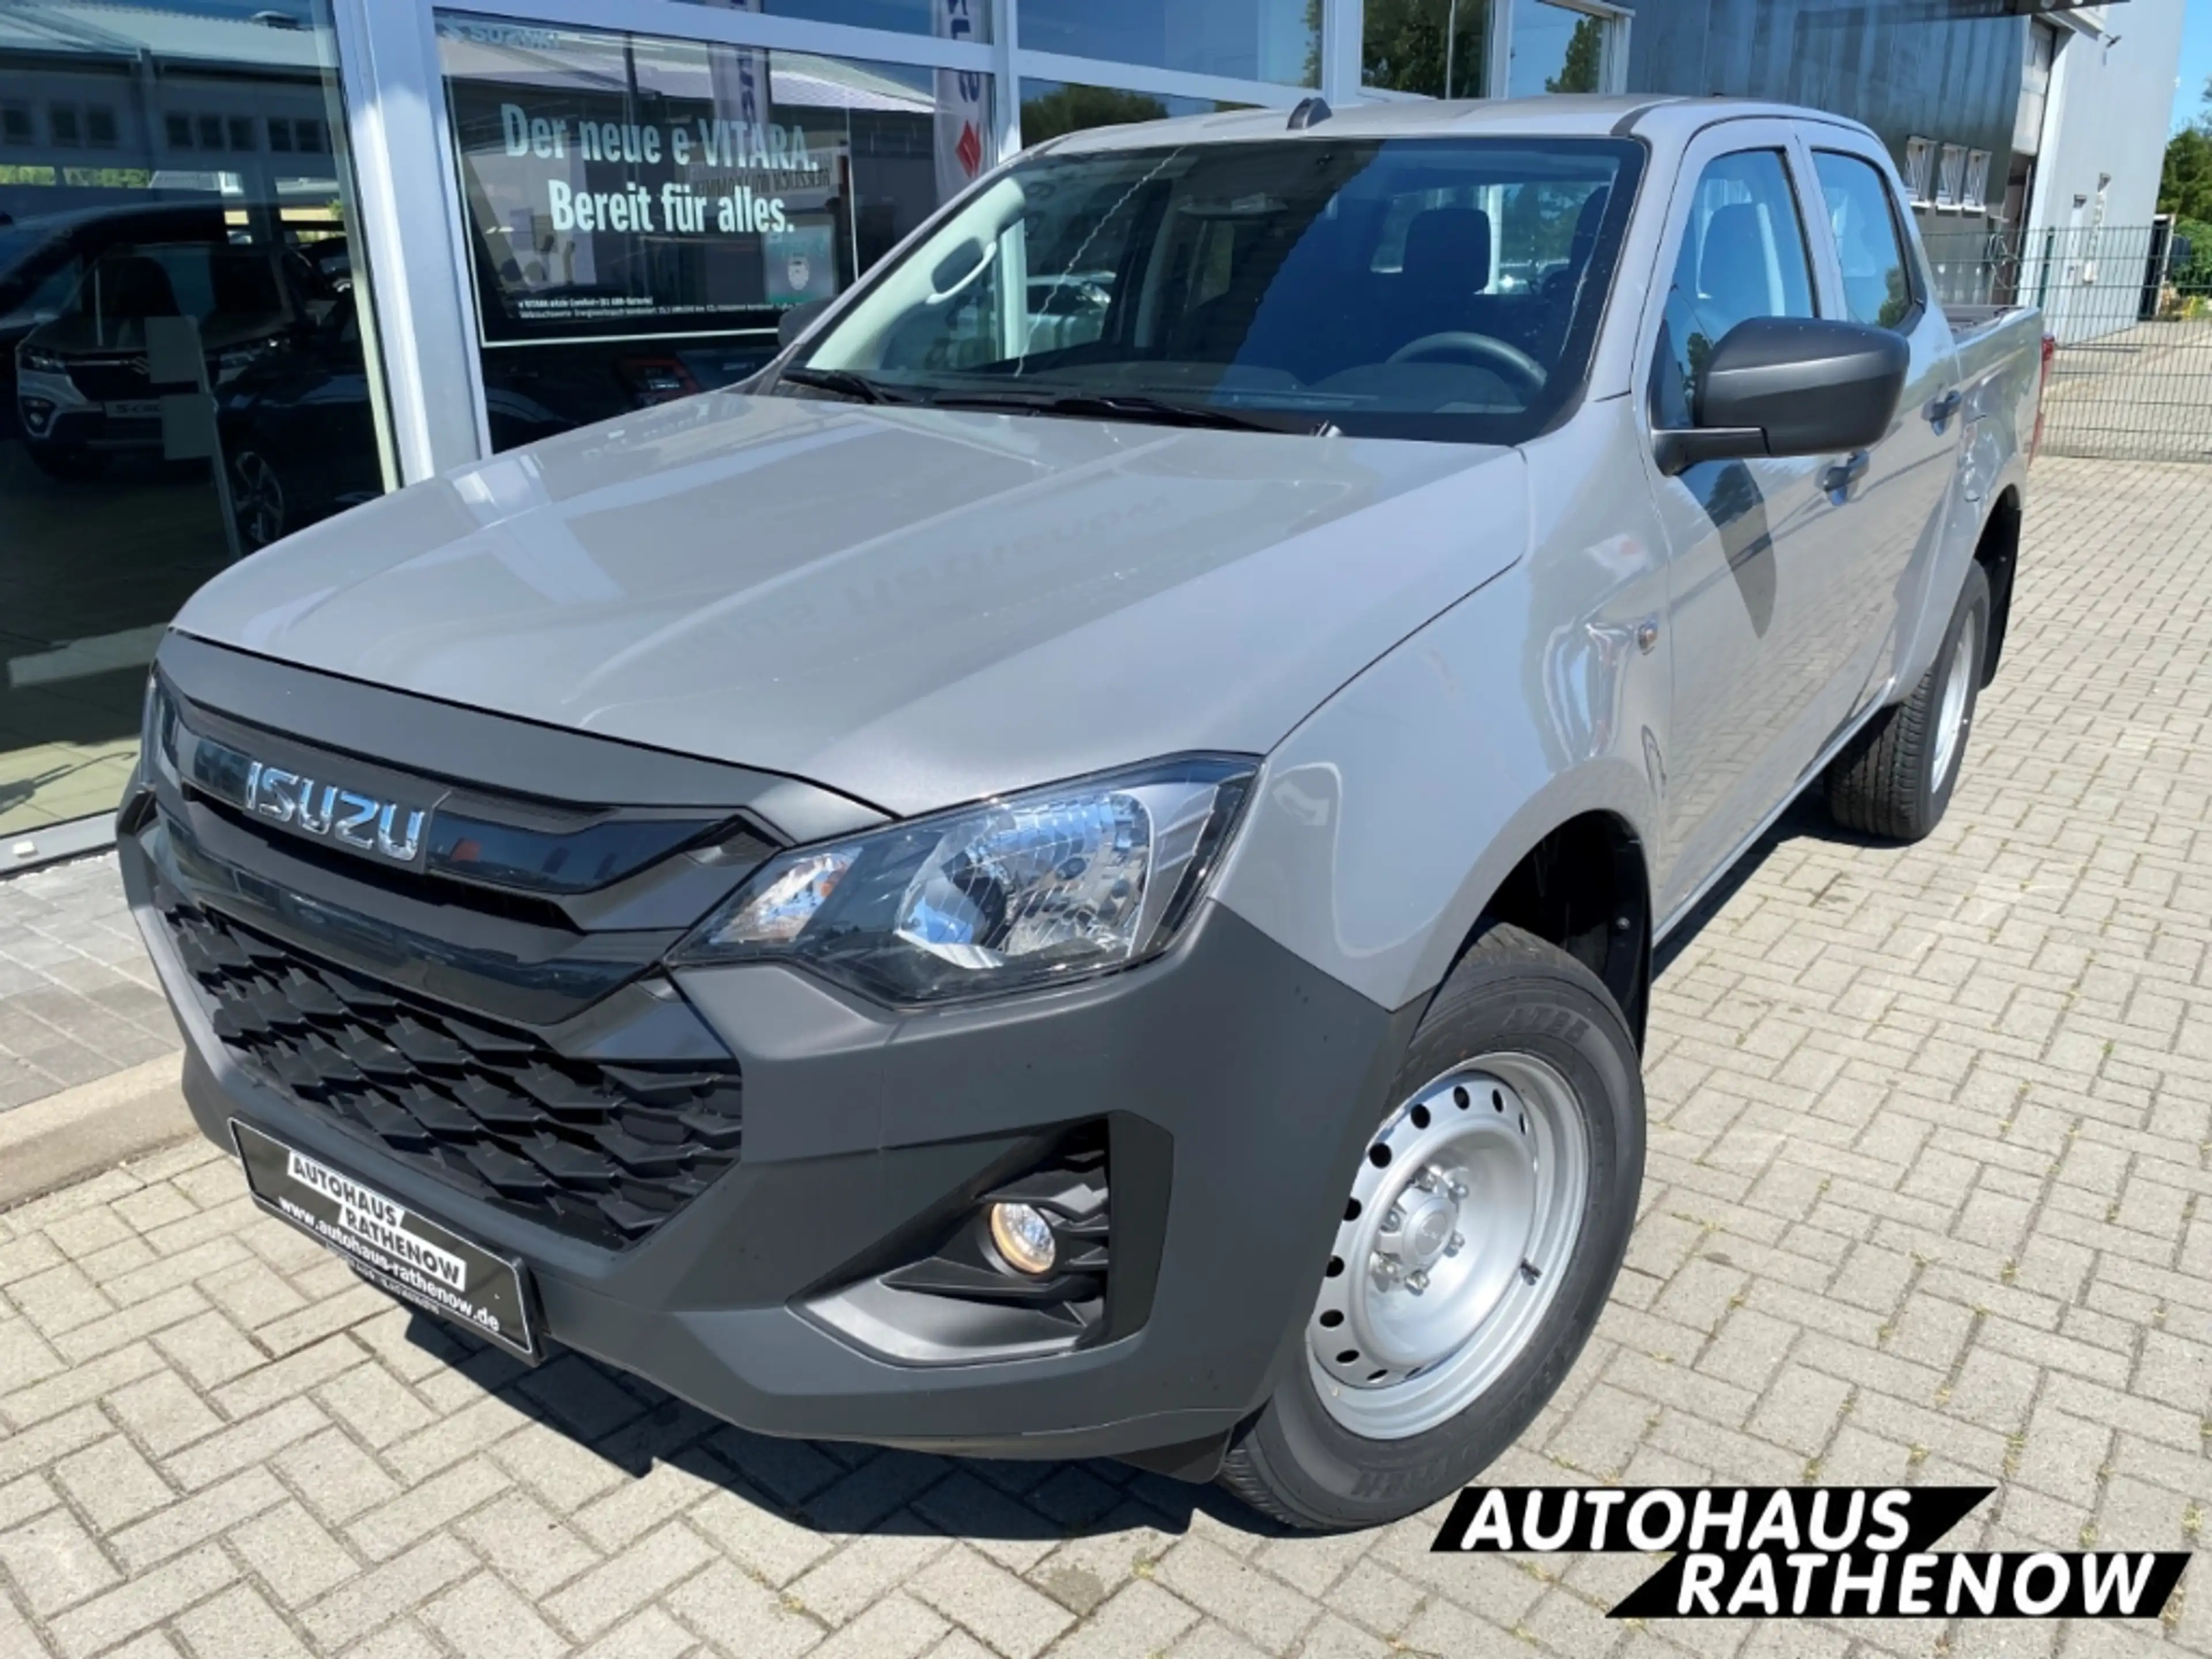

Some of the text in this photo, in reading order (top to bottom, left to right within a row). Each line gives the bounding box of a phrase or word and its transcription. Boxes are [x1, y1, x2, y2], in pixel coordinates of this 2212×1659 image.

[501, 103, 818, 171] Der neue e VITARA.
[548, 179, 794, 233] Bereit für alles.
[245, 761, 426, 861] ISUZU
[293, 1156, 397, 1226] AUTOHAUS
[279, 1196, 501, 1332] www.autohaus-rathenow.de
[346, 1208, 460, 1285] RATHENOW
